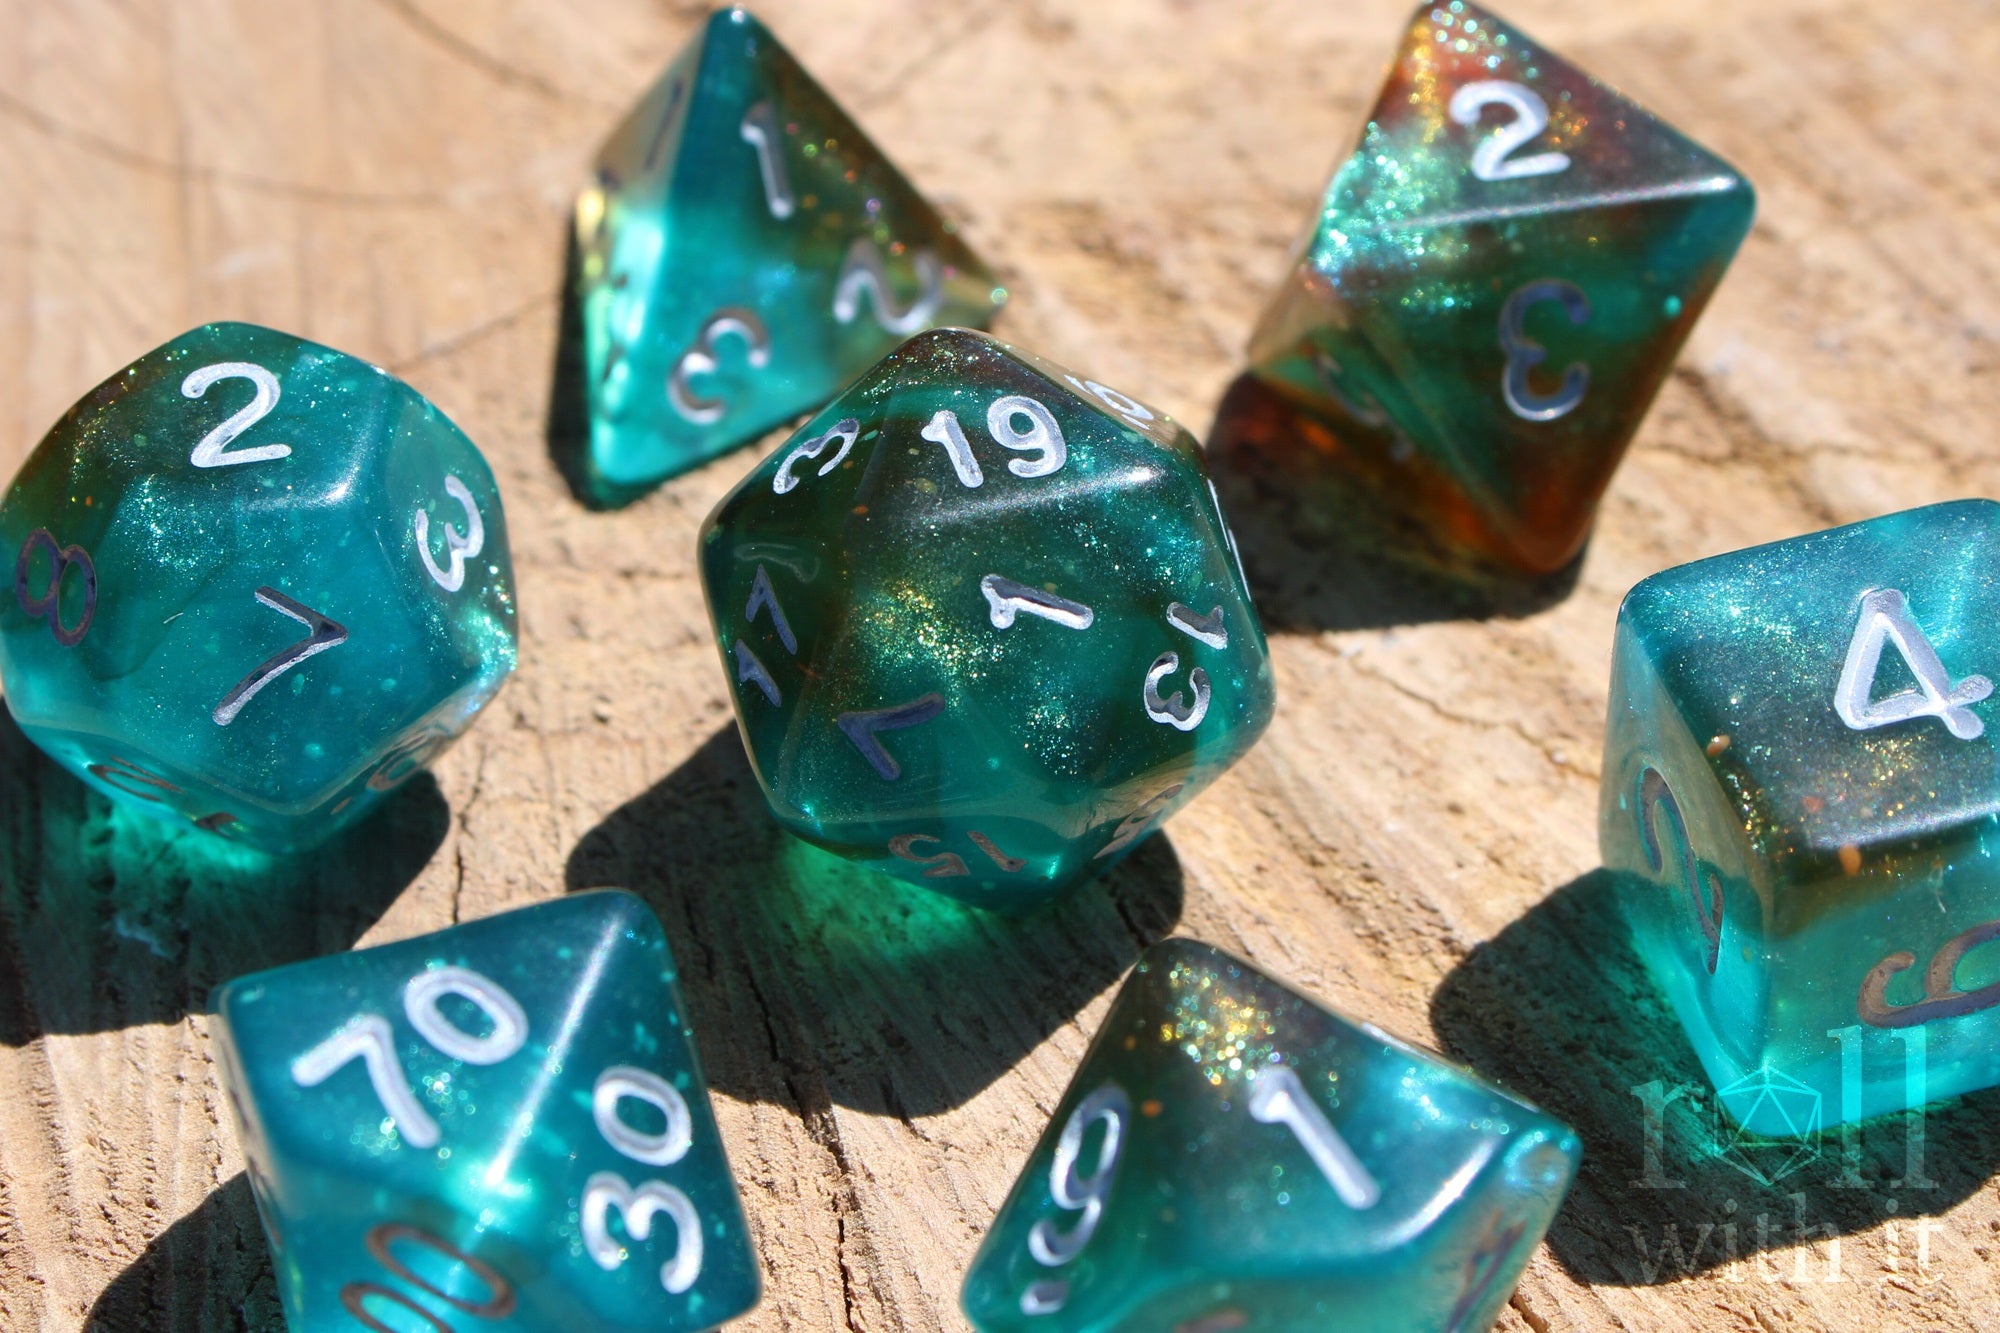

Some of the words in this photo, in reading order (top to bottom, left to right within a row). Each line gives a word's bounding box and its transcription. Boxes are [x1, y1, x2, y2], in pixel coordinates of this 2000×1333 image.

[741, 102, 794, 220] 1
[1449, 80, 1571, 181] 2
[668, 308, 769, 424] 3
[1502, 279, 1590, 421] 3
[181, 362, 291, 468] 2
[773, 419, 860, 494] 3
[922, 395, 1067, 488] 19
[15, 529, 98, 647] 8
[416, 476, 485, 592] 3
[212, 585, 348, 726] 7
[981, 574, 1093, 630] 1
[1144, 602, 1227, 731] 13
[1835, 588, 1994, 740] 4
[838, 693, 945, 781] 7
[290, 965, 528, 1149] 70
[581, 1066, 703, 1294] 30
[1249, 1065, 1380, 1209] 1
